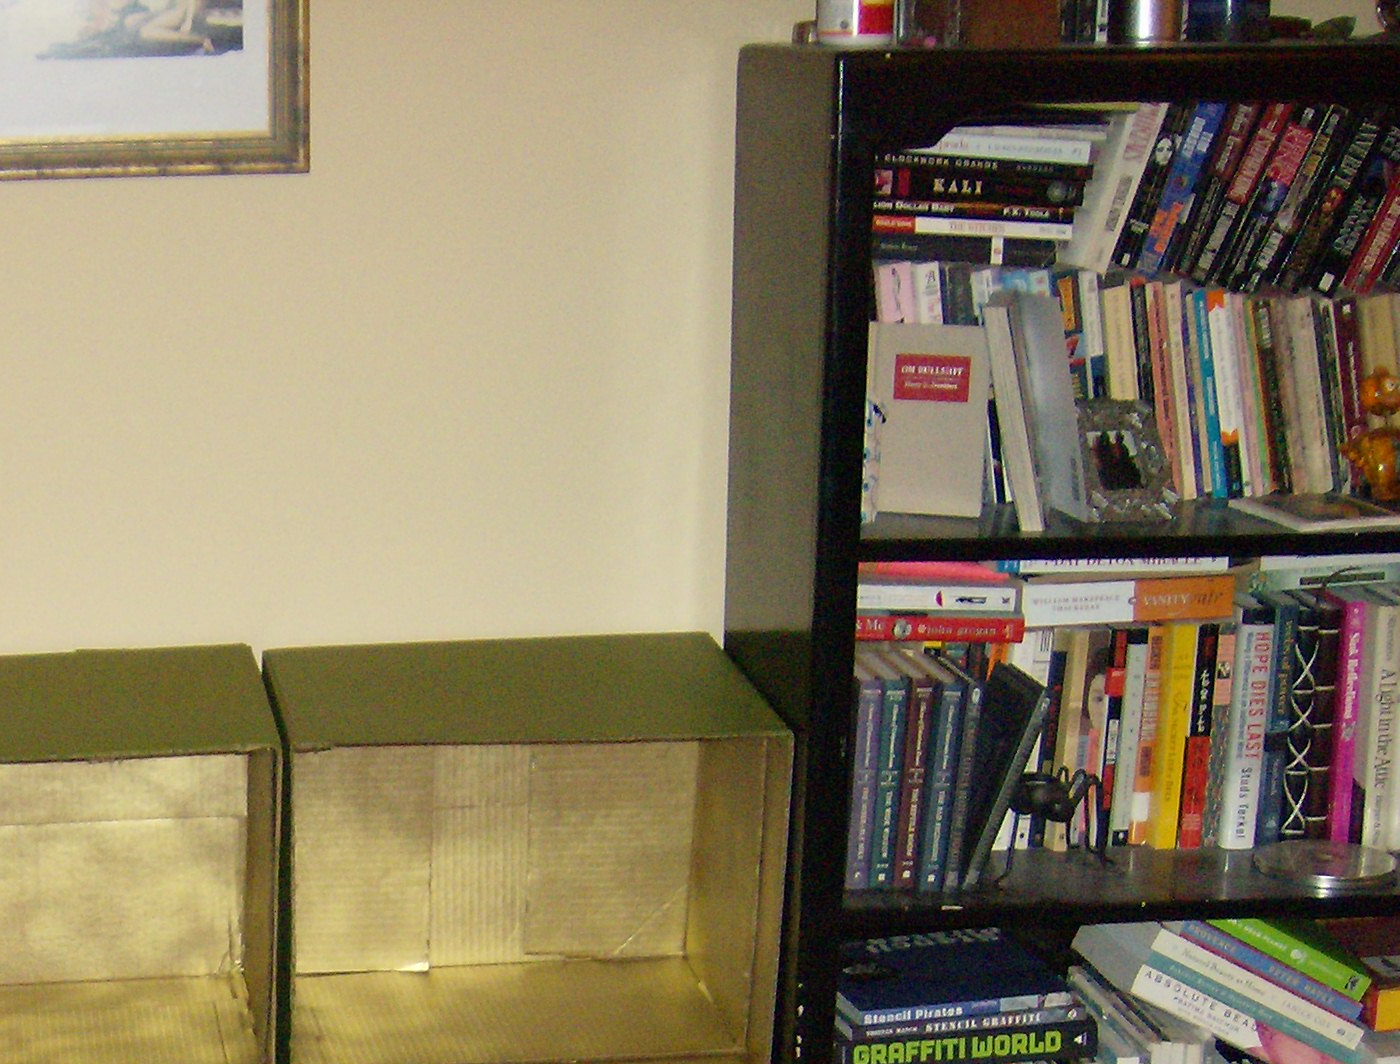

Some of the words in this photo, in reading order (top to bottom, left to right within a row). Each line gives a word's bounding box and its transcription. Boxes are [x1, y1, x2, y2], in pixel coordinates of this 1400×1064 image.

[932, 177, 982, 195] KALI
[1248, 630, 1273, 676] HOPE
[1245, 679, 1268, 718] DIES
[1374, 682, 1396, 716] Light
[1242, 722, 1261, 759] LAST
[1379, 718, 1394, 732] in
[1377, 733, 1392, 755] the
[1237, 766, 1253, 799] Studs
[1372, 756, 1391, 789] Attic
[1233, 802, 1249, 839] Terkel
[1143, 968, 1218, 1012] ABSOLUTE
[862, 1009, 912, 1026] Stencil
[914, 1004, 963, 1020] Pirates
[923, 1018, 978, 1033] STENCIL
[981, 1011, 1041, 1028] GRAFFITI
[969, 1029, 1062, 1059] WORLD
